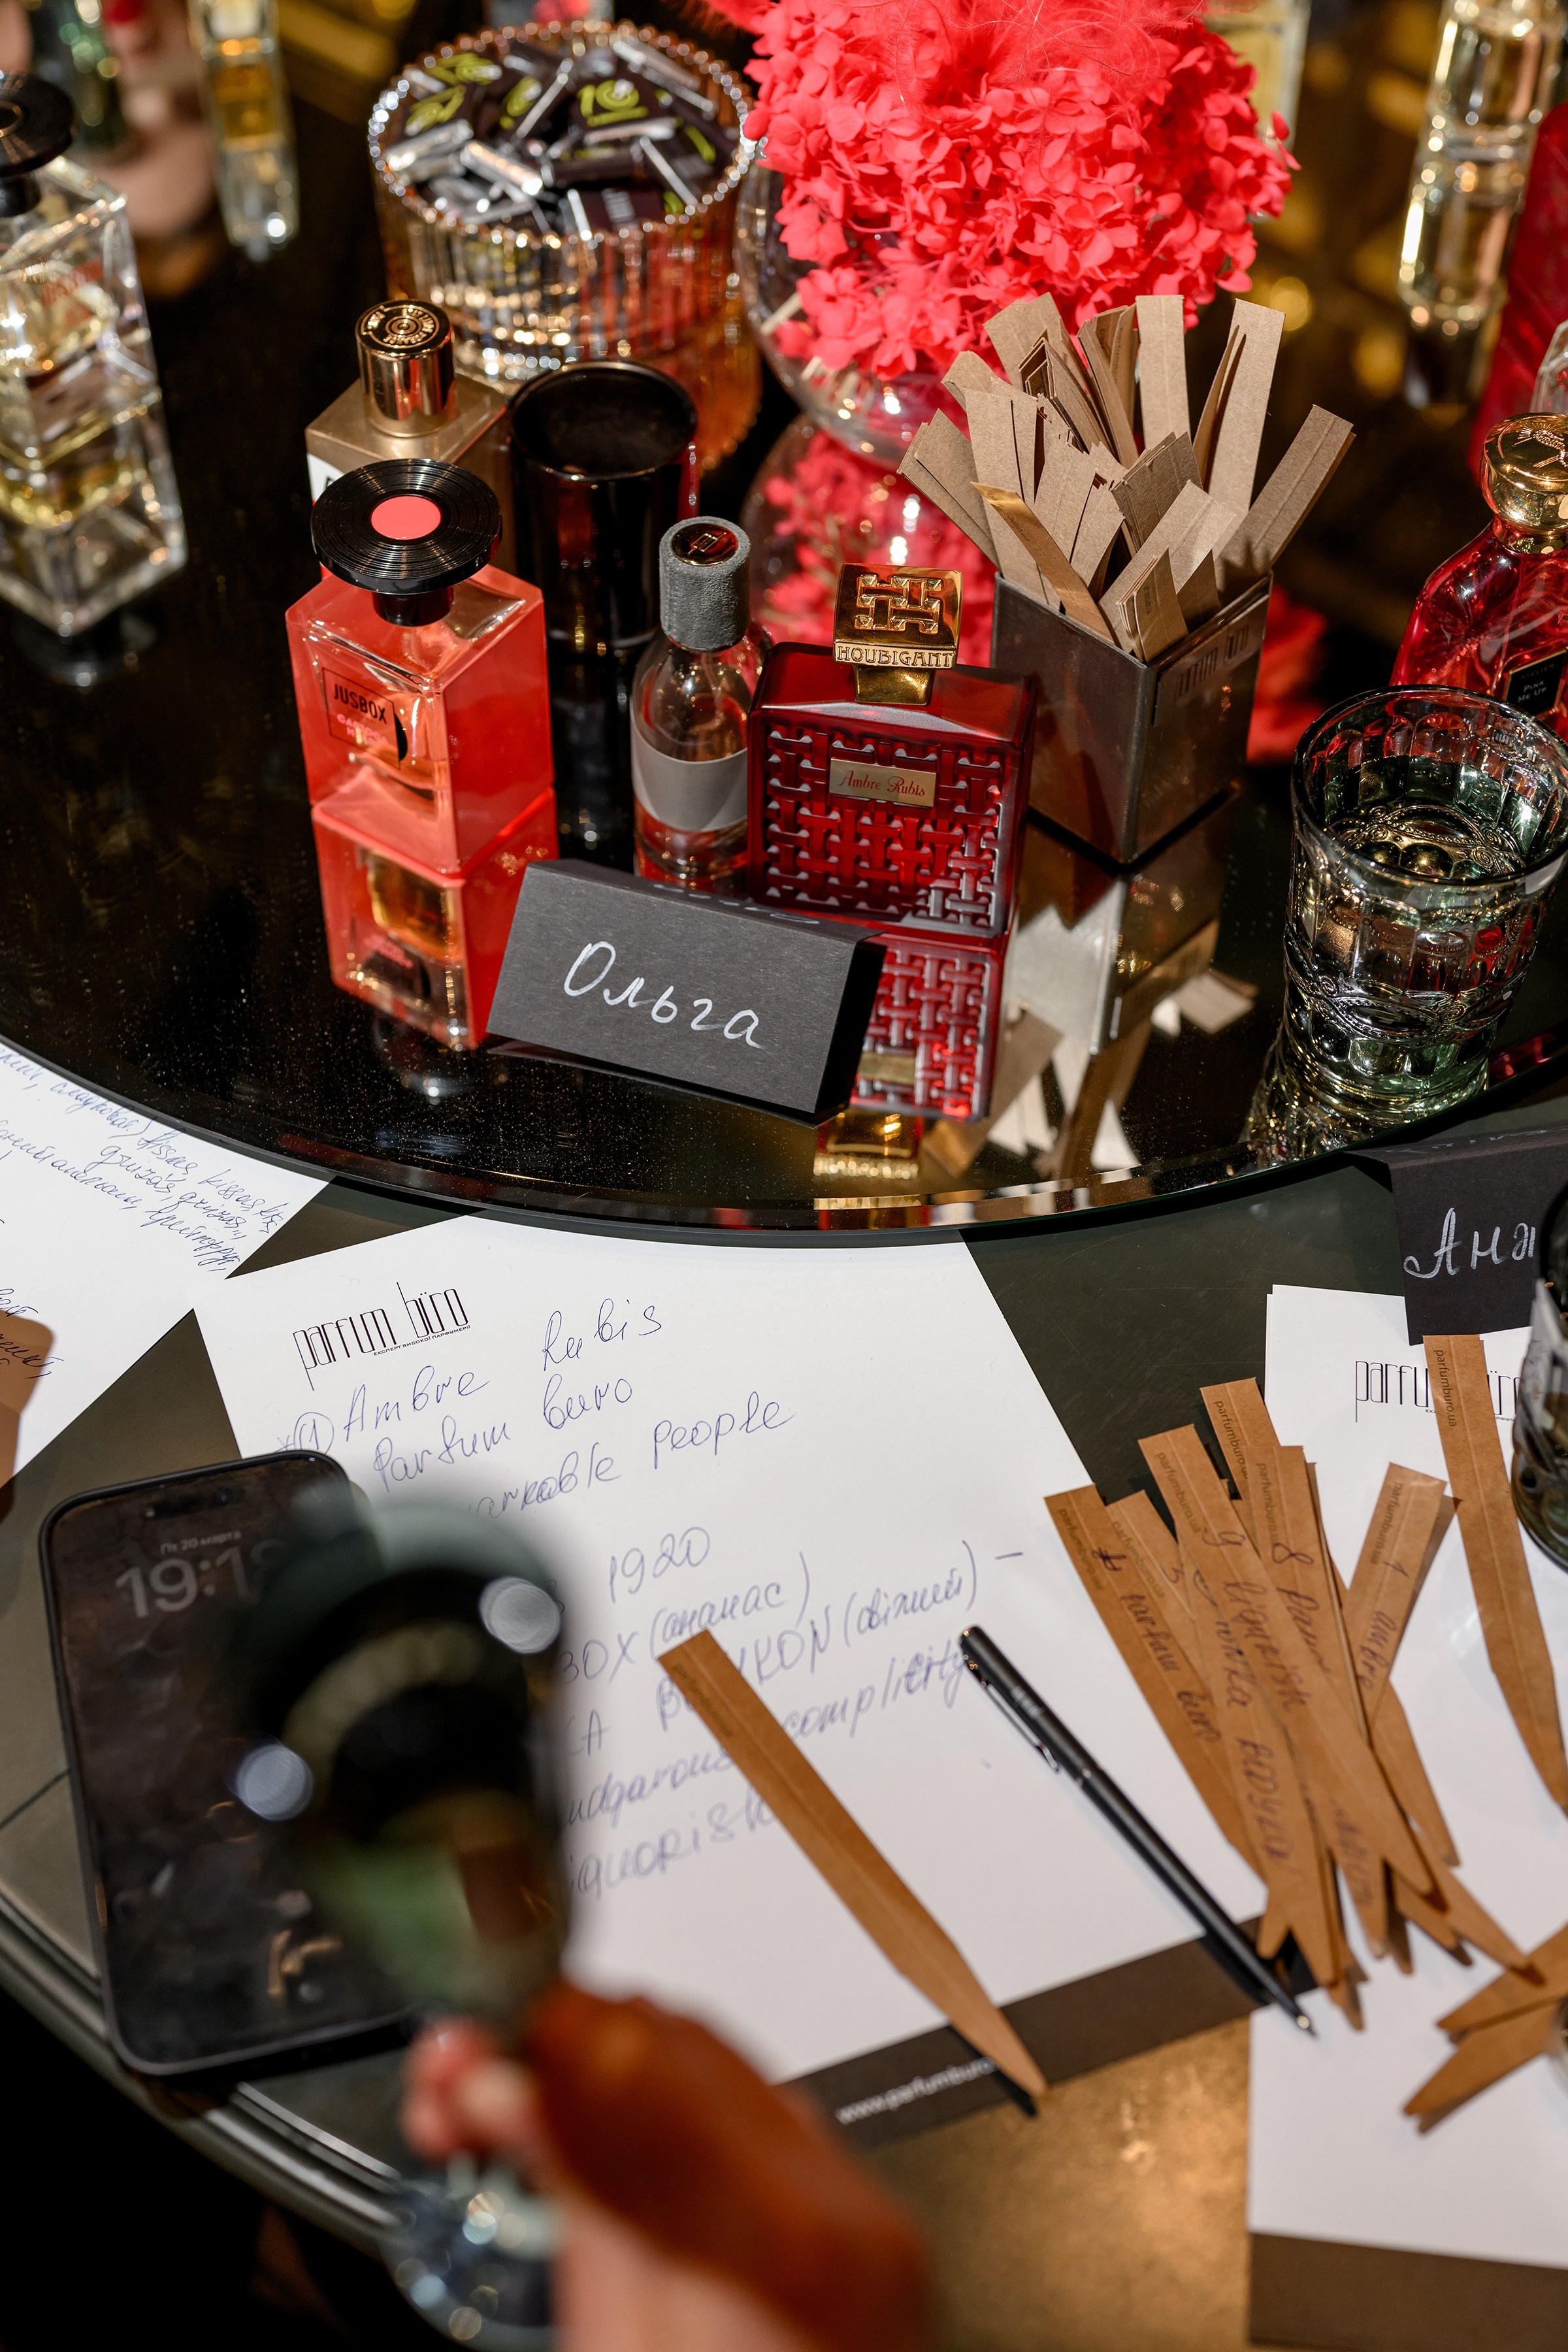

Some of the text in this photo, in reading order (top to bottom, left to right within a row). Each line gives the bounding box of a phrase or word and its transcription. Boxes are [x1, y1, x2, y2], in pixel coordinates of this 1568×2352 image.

[837, 645, 954, 668] HOUBIGANT
[334, 683, 388, 725] JUSBOX
[838, 770, 925, 796] Ambre Rubis
[563, 941, 764, 1050] Ольга
[292, 1308, 397, 1392] parfum
[373, 1324, 472, 1356] ЕКСПЕРТ ВИСОКОЇ ПАРФУМЕРІЇ
[1355, 1360, 1432, 1424] parfu
[1433, 1349, 1458, 1428] parfumburo.ua
